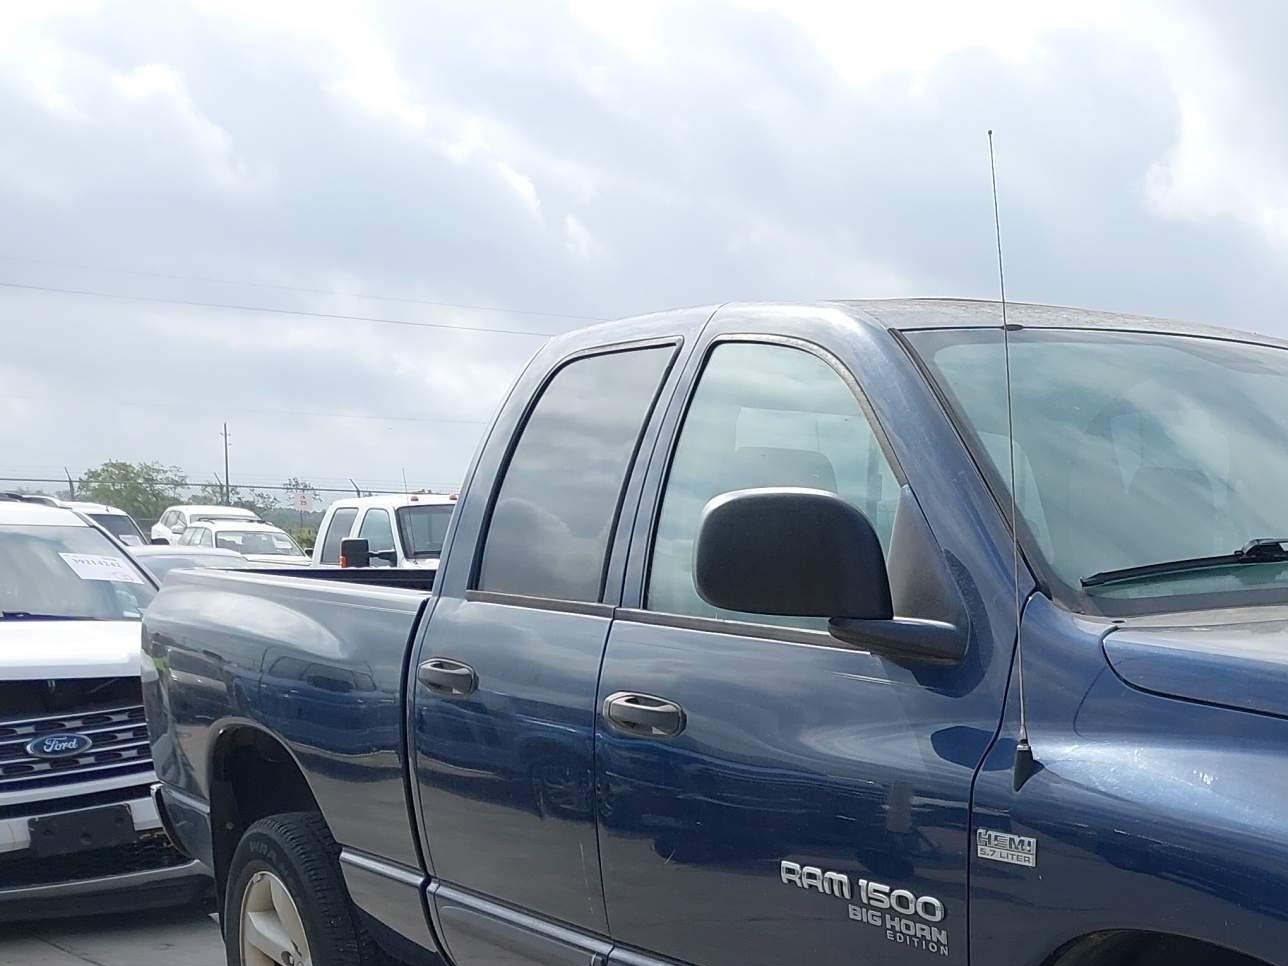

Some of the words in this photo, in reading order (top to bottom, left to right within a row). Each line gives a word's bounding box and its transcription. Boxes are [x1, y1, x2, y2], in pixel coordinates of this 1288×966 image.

[43, 736, 78, 752] Ford
[978, 830, 1034, 853] HEMI
[980, 847, 996, 857] 5.7
[1000, 850, 1032, 865] LITER
[780, 860, 851, 899] RAM
[858, 879, 945, 922] 1500
[848, 904, 882, 926] BIG
[885, 914, 948, 945] HORN
[887, 930, 949, 956] EDITION
